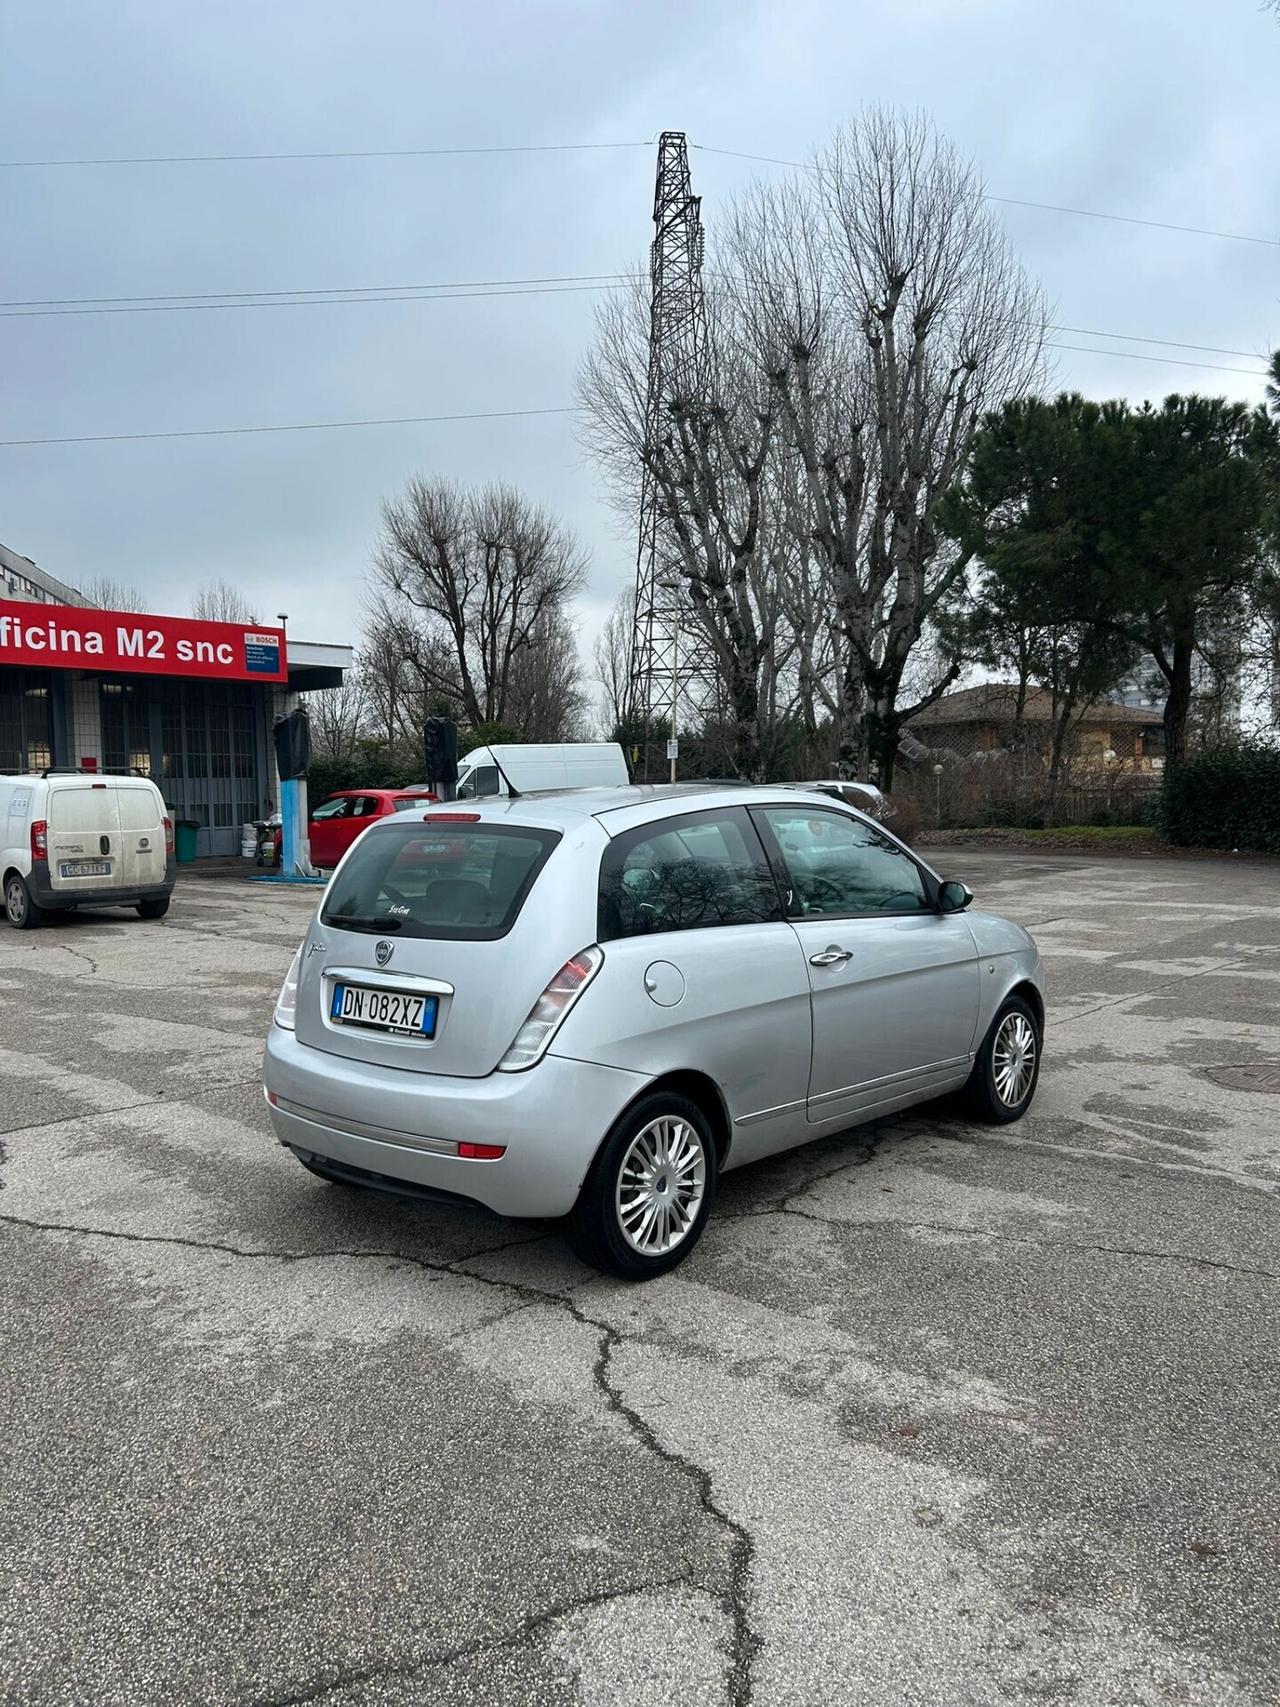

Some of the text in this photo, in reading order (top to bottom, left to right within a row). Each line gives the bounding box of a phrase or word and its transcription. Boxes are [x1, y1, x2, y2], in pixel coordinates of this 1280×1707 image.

[0, 616, 104, 654] ficina
[116, 627, 166, 659] M2
[176, 638, 234, 665] snc
[255, 636, 277, 644] BOSCH
[344, 989, 423, 1028] DN 082XZ
